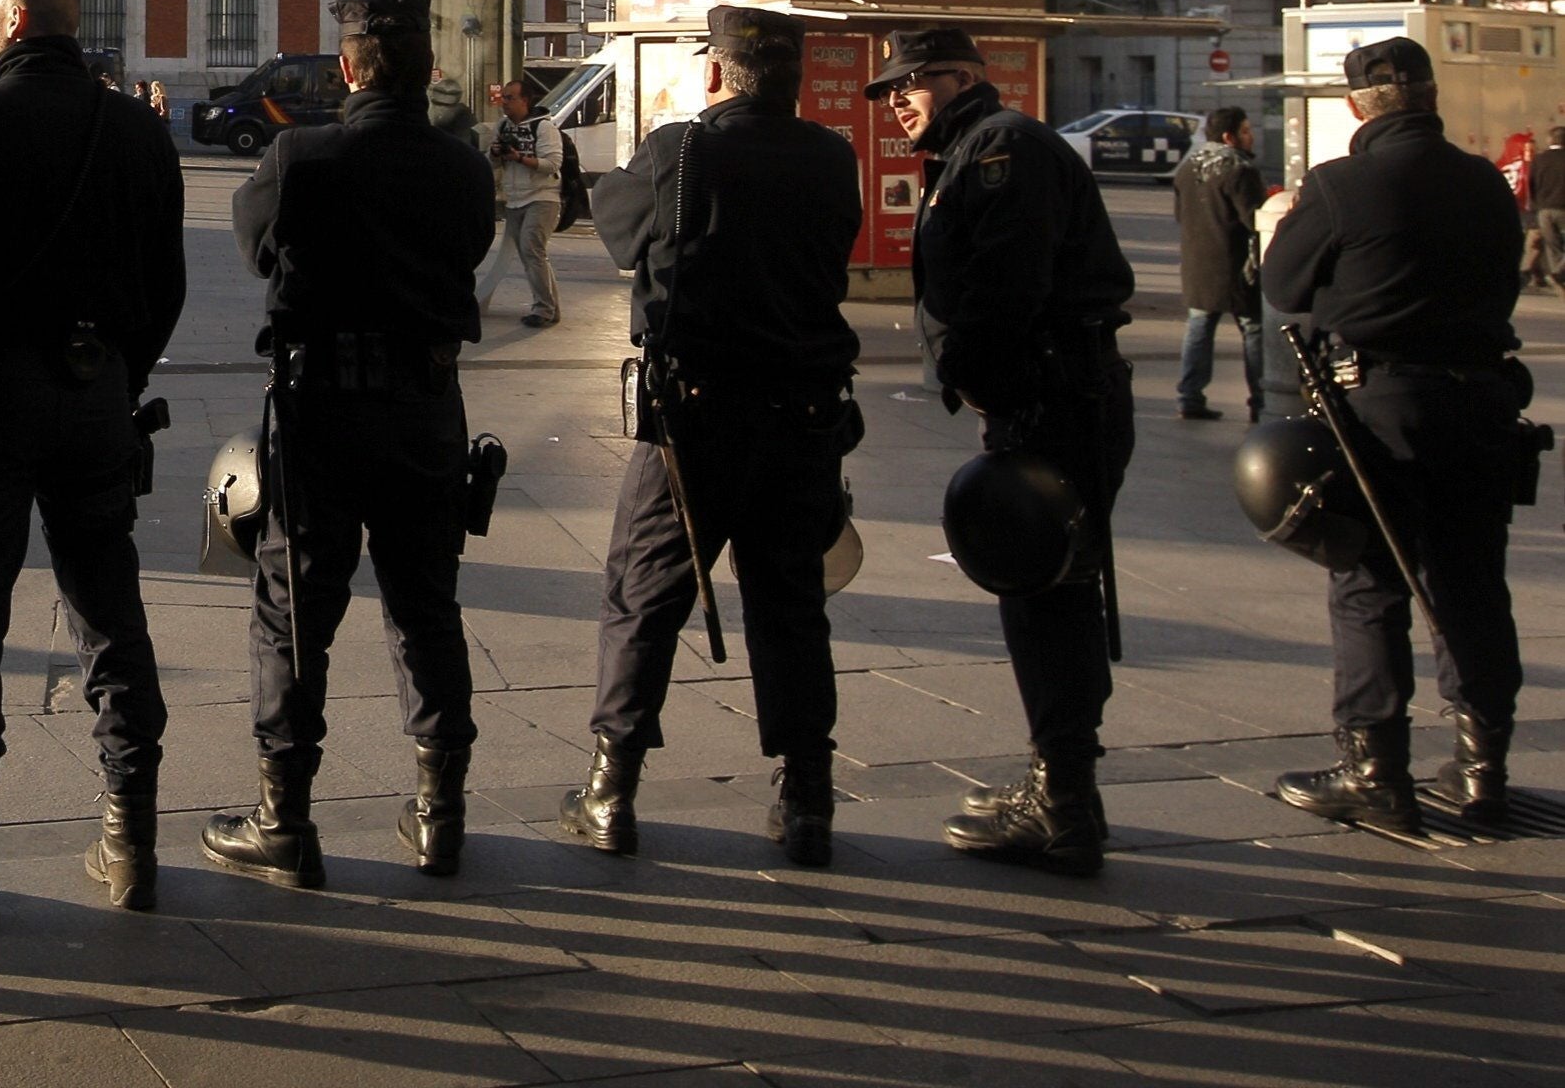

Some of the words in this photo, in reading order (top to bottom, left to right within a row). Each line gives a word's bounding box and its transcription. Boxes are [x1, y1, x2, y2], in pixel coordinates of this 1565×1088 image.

[812, 47, 857, 62] MADRID
[812, 80, 839, 92] COMPRE
[819, 98, 832, 109] BUY
